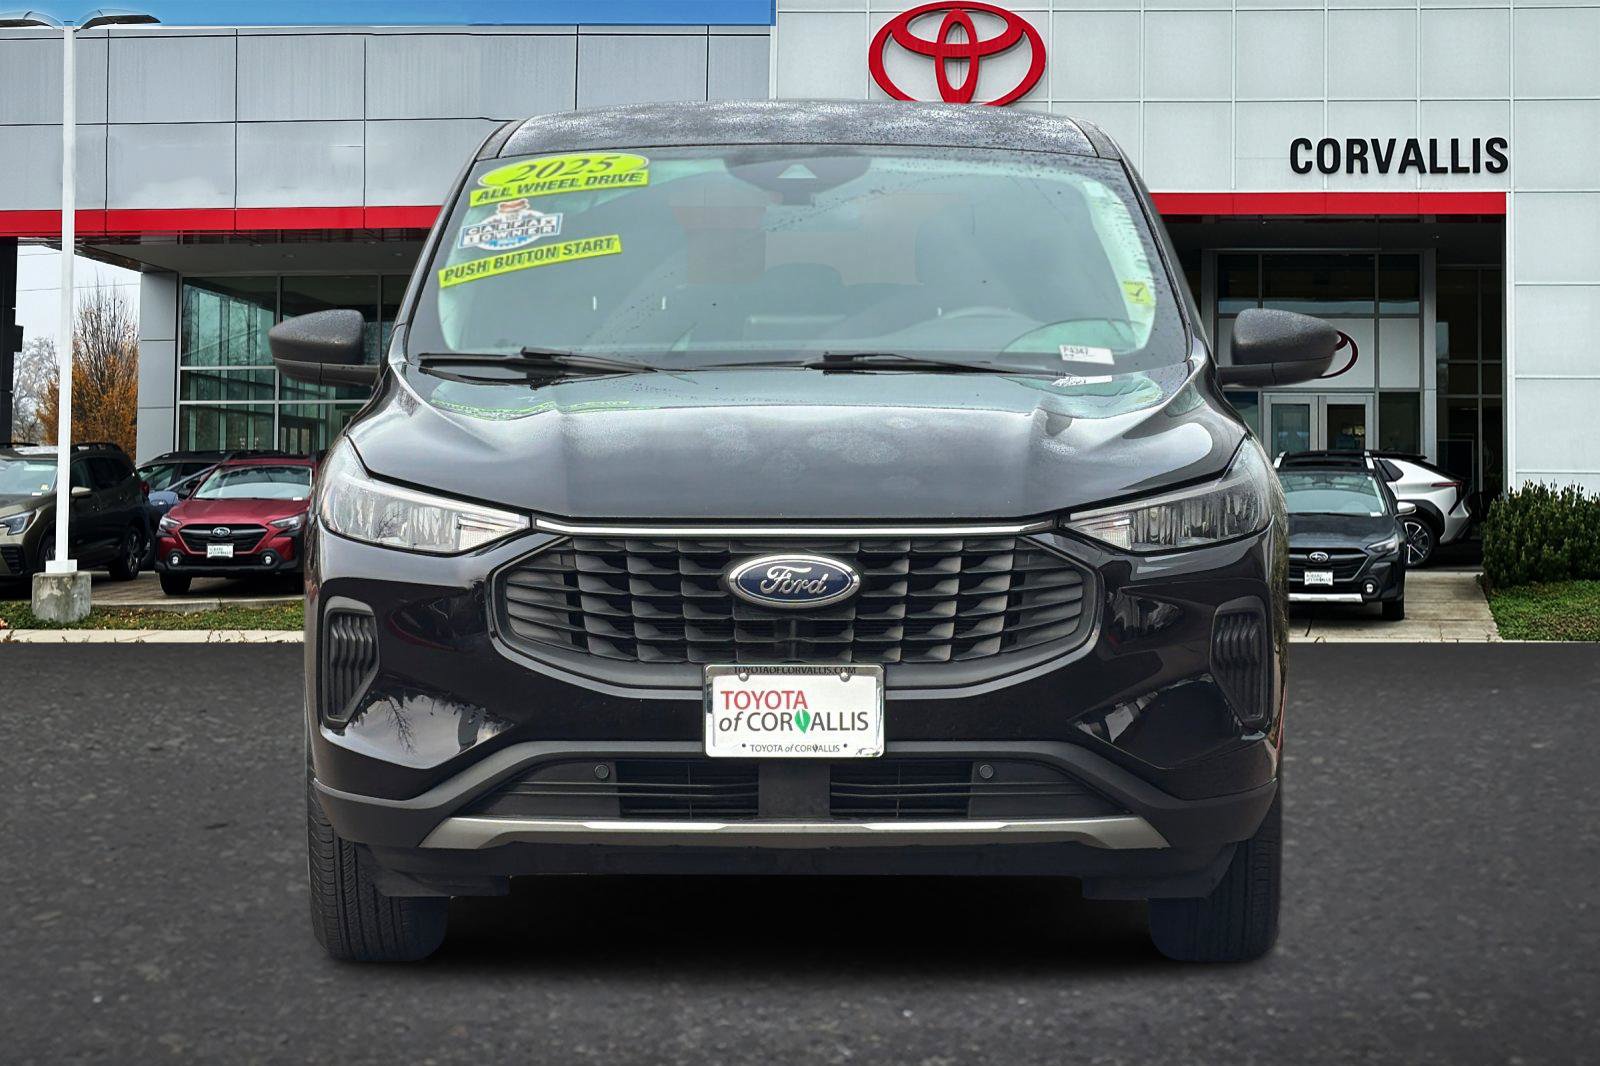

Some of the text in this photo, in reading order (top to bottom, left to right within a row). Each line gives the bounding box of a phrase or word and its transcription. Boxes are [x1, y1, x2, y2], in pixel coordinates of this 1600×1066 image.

[505, 155, 620, 182] 2025
[1290, 137, 1509, 174] CORVALLIS
[476, 171, 643, 202] ALL WHEEL DRIVE
[443, 237, 616, 282] PUSH BUTTON START
[760, 565, 829, 594] Ford
[720, 690, 809, 710] TOYOTA
[719, 710, 869, 733] of CORVALLIS
[750, 744, 840, 753] TOYOTA of CORVALLIS
